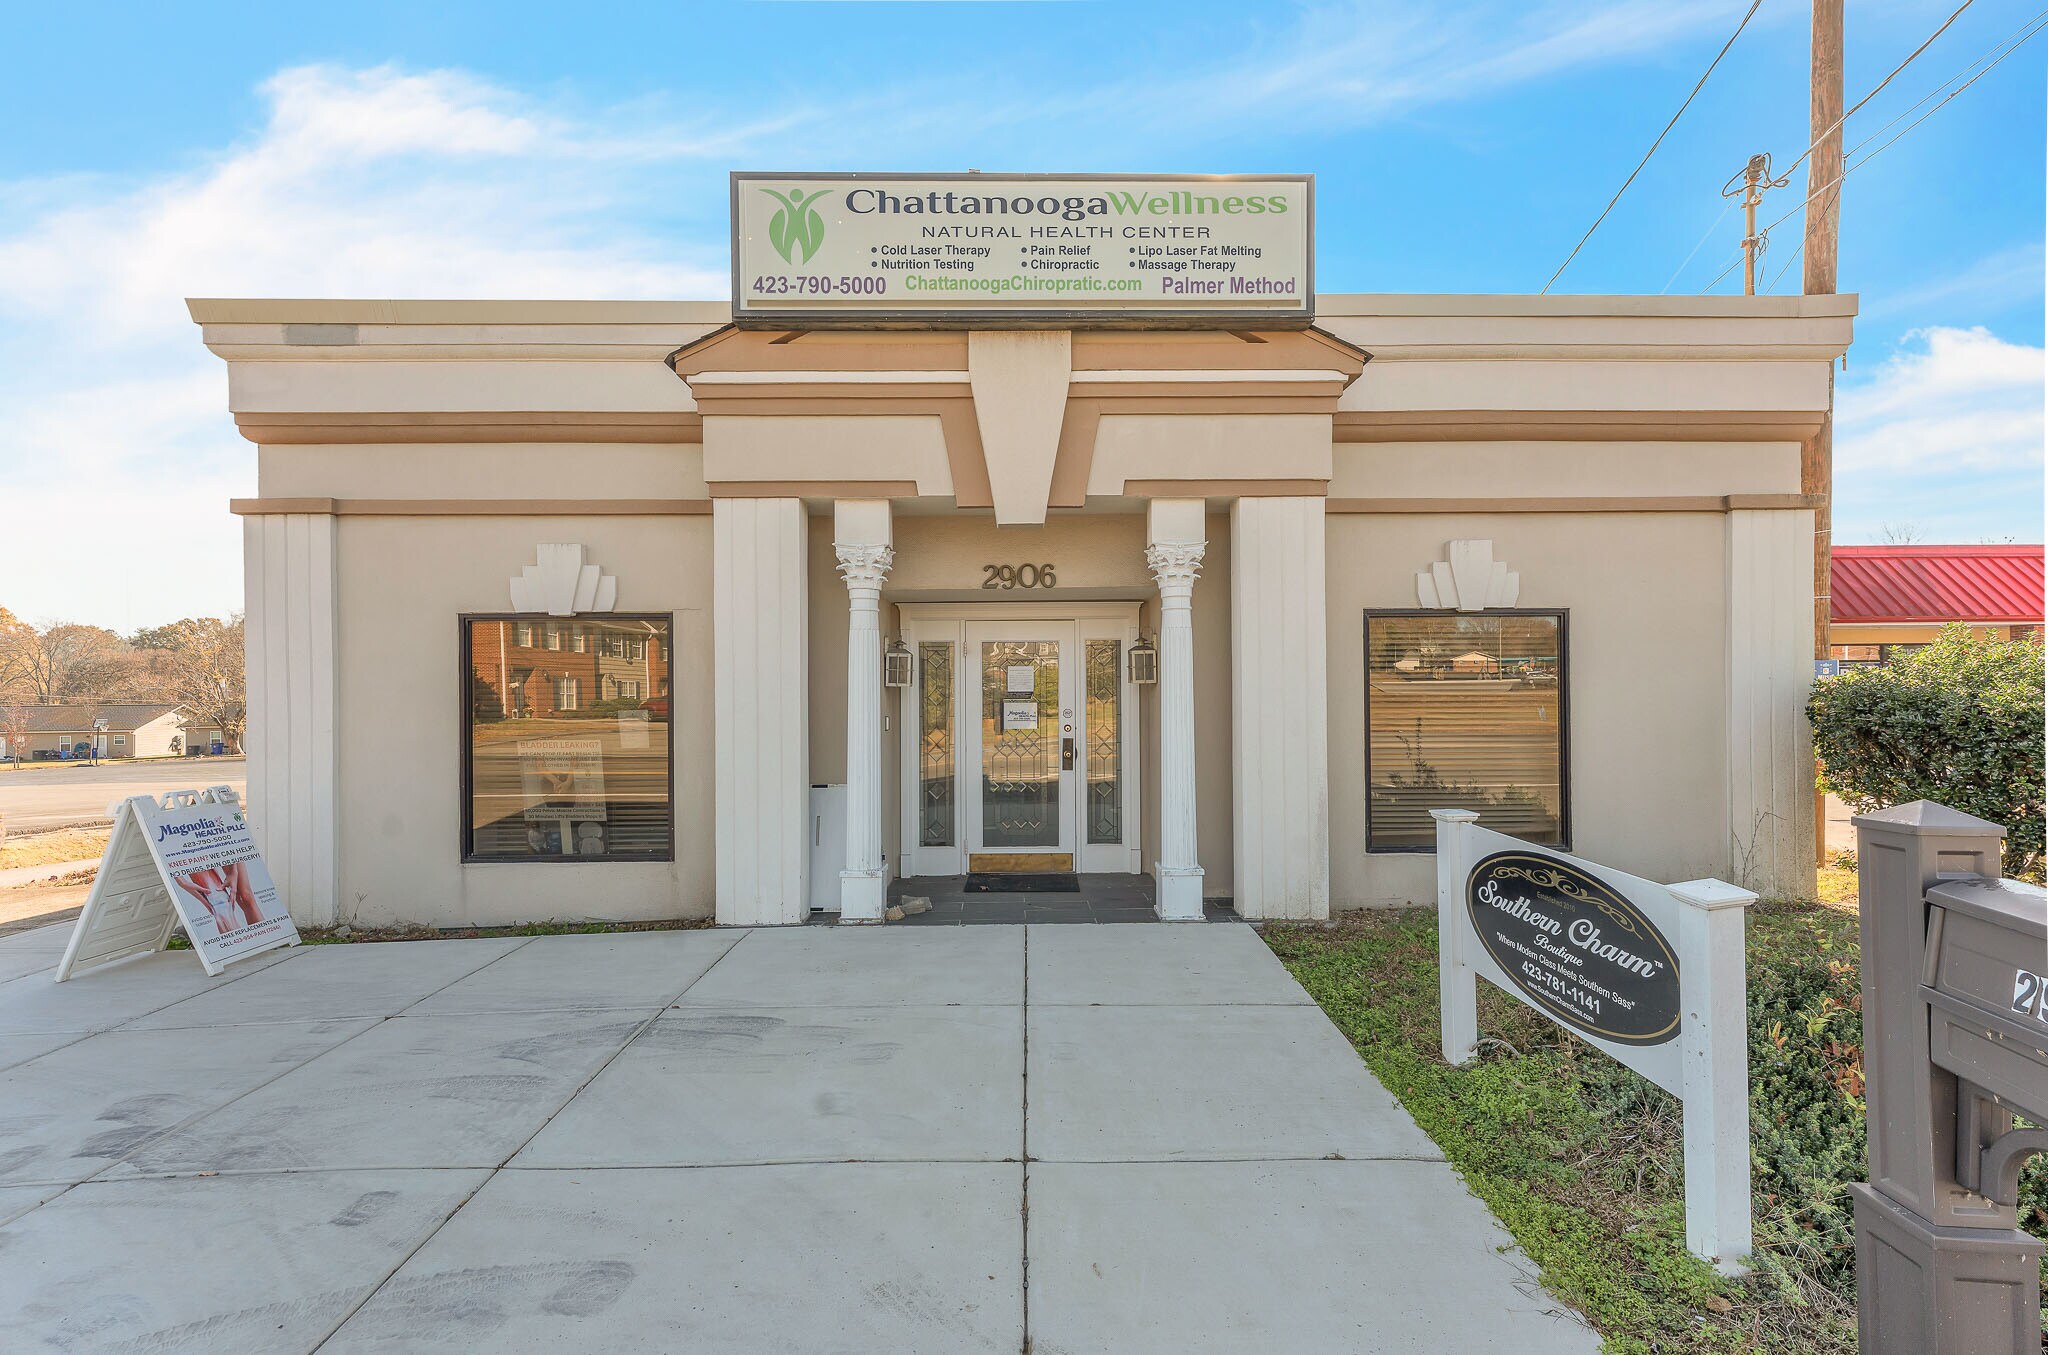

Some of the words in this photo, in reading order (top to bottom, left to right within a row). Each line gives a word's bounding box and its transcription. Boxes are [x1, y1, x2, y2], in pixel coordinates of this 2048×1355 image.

[922, 226, 1022, 238] NATURAL
[1030, 226, 1113, 238] HEALTH
[1122, 226, 1210, 239] CENTER
[881, 245, 909, 256] Cold
[910, 245, 943, 256] Laser
[944, 245, 991, 259] Therapy
[1030, 246, 1055, 256] Pain
[1059, 245, 1091, 256] Relief
[1138, 246, 1163, 258] Lipo
[1166, 246, 1198, 256] Laser
[1200, 246, 1218, 256] Fat
[1221, 246, 1262, 259] Melting
[881, 259, 930, 270] Nutrition
[933, 259, 974, 272] Testing
[1030, 259, 1100, 273] Chiropractic
[1138, 260, 1188, 273] Massage
[1190, 260, 1236, 273] Therapy
[753, 276, 887, 295] 423-790-5000
[905, 275, 1142, 294] ChattanoogaChiropratic.com
[1162, 277, 1225, 294] Palmer
[1230, 277, 1296, 294] Method
[982, 563, 1057, 590] 2906
[158, 818, 215, 842] Magnolia
[227, 824, 246, 833] PLLC
[168, 860, 188, 868] KNEE
[189, 855, 209, 865] PAIN?
[221, 850, 236, 858] CAN
[236, 845, 255, 854] HELP!
[206, 862, 221, 871] PAIN
[203, 936, 220, 946] AVOID
[221, 932, 235, 941] KNEE
[235, 919, 272, 936] REPLACEMENTS
[1478, 880, 1563, 936] Southern
[1568, 918, 1656, 978] Charm
[220, 940, 234, 949] CALL
[1533, 934, 1584, 966] Boutique
[1516, 942, 1538, 960] Modern
[1539, 954, 1556, 970] Class
[1557, 963, 1577, 981] Meets
[1578, 974, 1611, 999] Southern
[1522, 960, 1600, 1014] 423-781-1141
